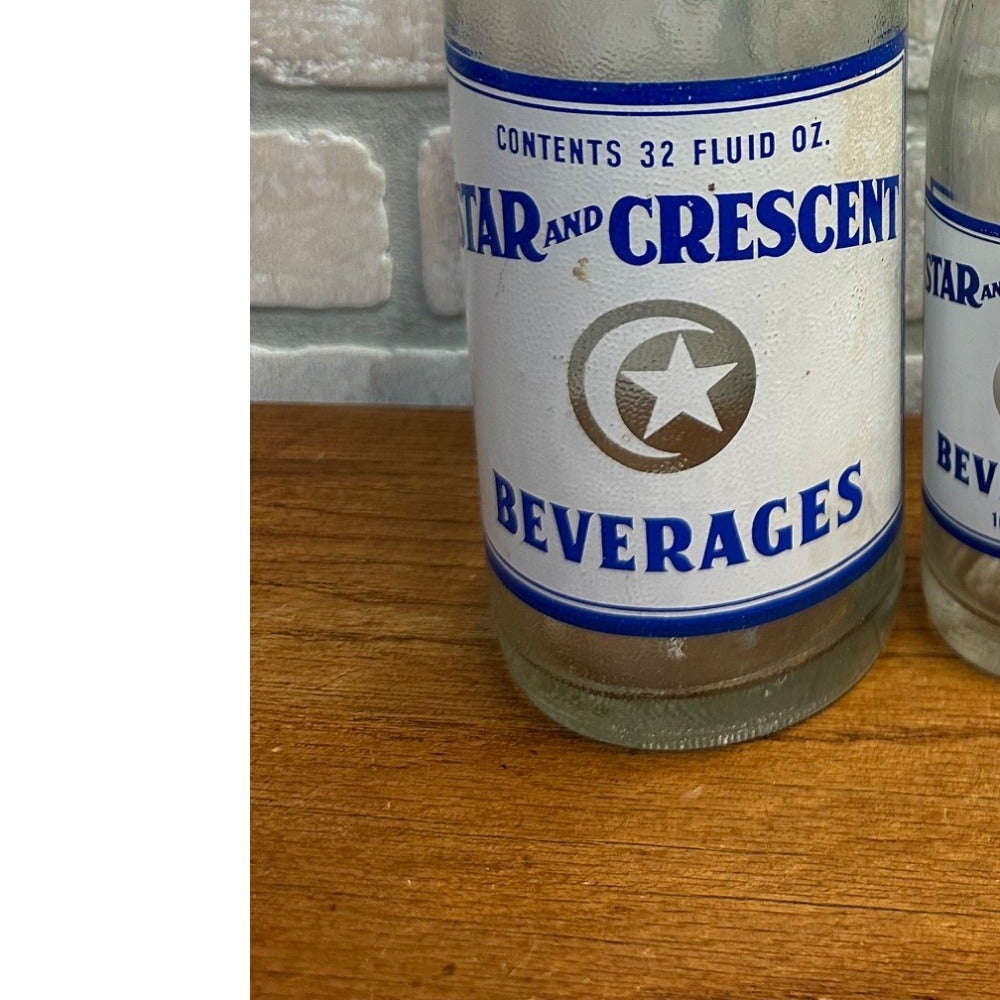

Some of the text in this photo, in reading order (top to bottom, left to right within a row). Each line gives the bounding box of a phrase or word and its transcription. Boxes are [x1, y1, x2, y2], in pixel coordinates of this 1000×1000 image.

[496, 121, 830, 168] CONTENTS 32 FLUID OZ.
[543, 204, 604, 248] AND
[609, 175, 899, 266] CRESCENT
[493, 461, 863, 573] BEVERAGES
